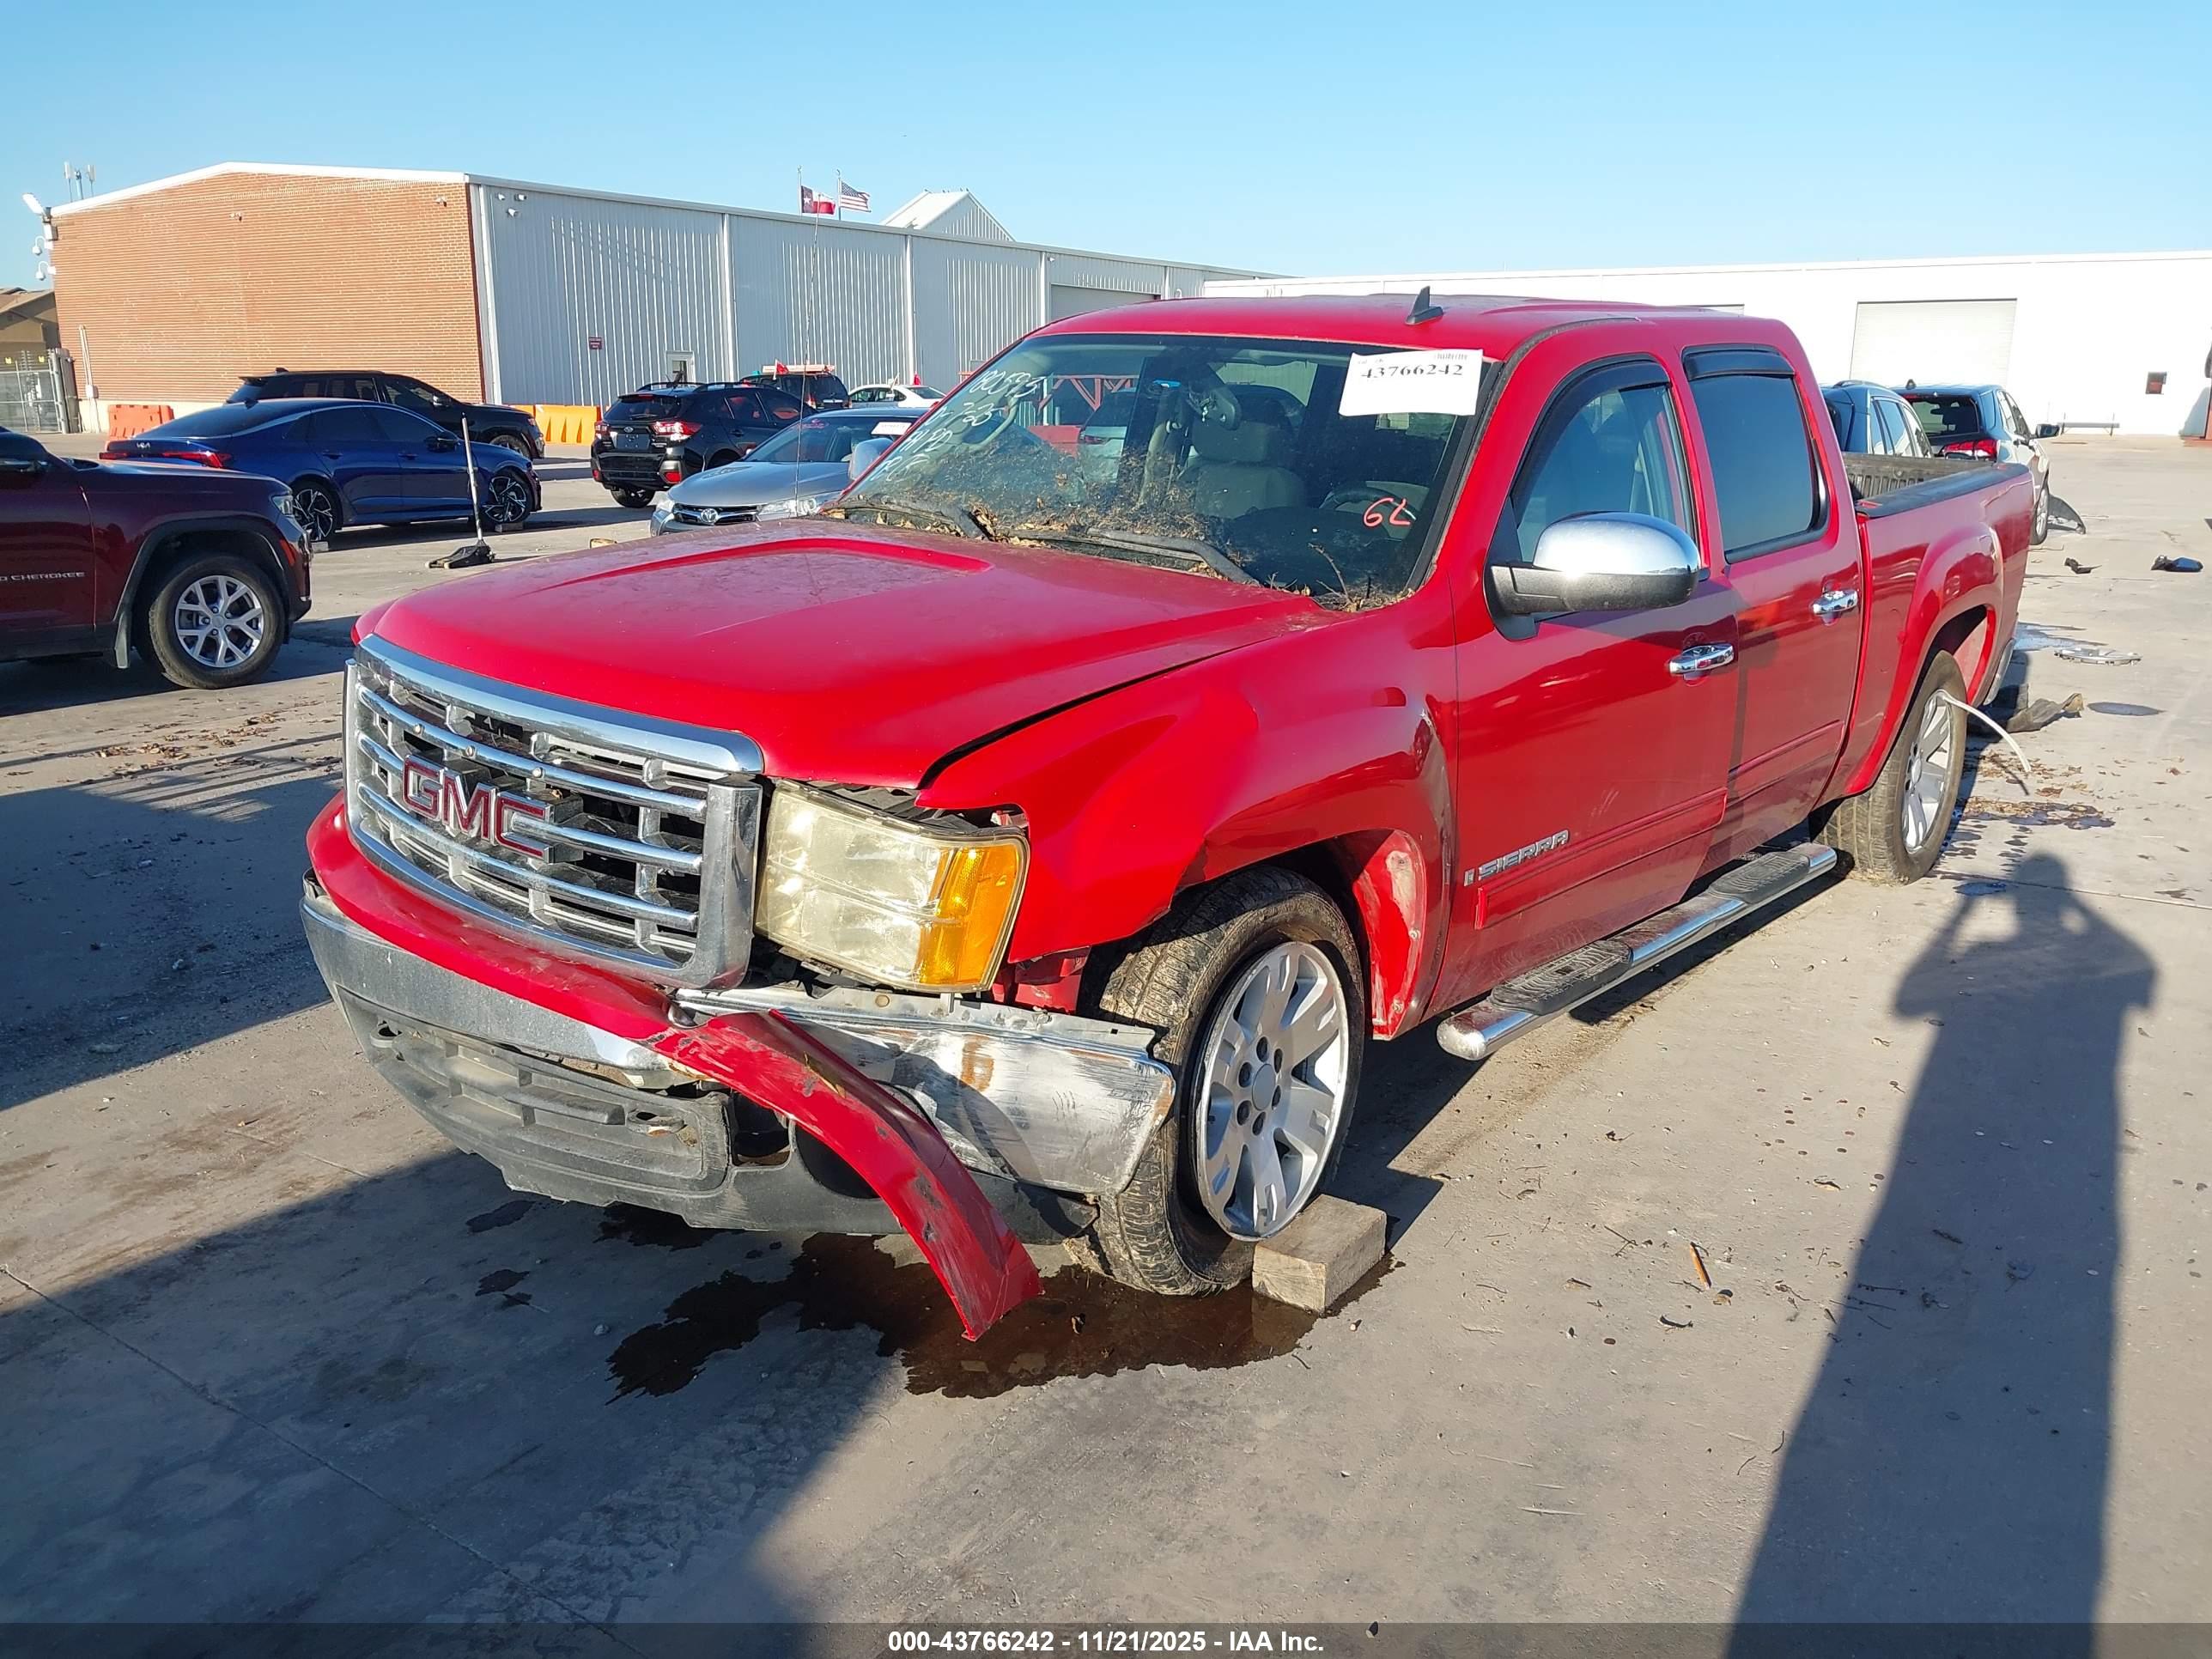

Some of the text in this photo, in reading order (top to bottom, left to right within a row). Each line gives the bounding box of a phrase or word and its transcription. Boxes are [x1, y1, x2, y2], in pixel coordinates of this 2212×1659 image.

[1361, 364, 1463, 379] 43766242
[10, 571, 85, 580] CHEROKEE
[403, 755, 550, 862] GMC
[1478, 830, 1570, 881] SIERRA
